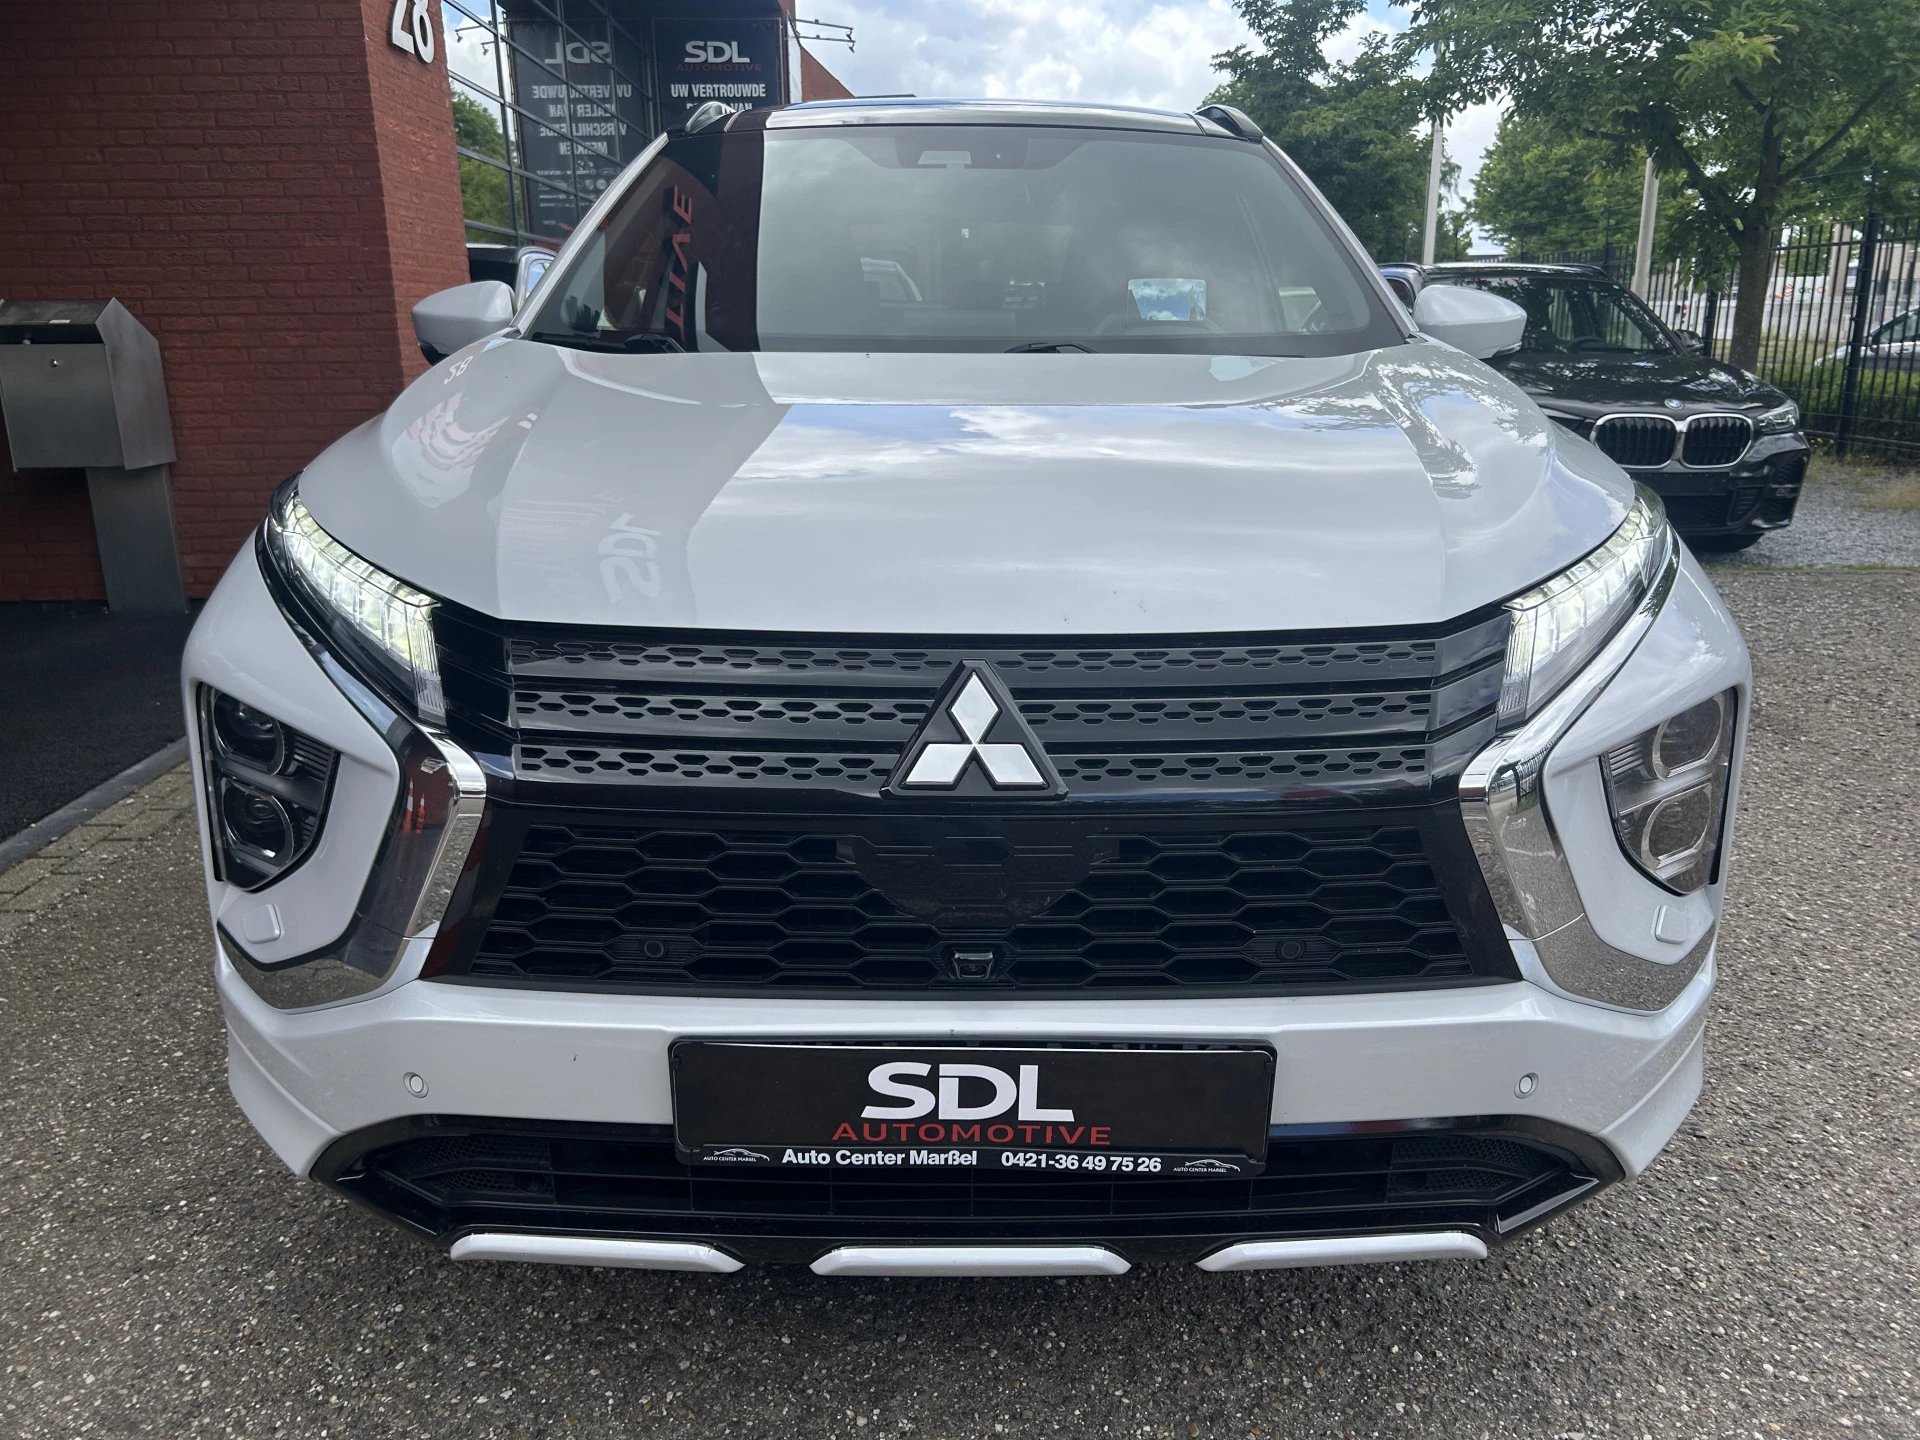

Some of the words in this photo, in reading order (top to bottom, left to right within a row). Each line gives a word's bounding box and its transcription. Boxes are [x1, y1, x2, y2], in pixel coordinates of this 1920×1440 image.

[684, 41, 751, 63] SDL
[676, 63, 762, 72] AUTOMOTIVE
[670, 84, 690, 98] UW
[691, 84, 767, 98] VERTROUWDE
[861, 1061, 1075, 1122] SDL
[831, 1122, 1112, 1145] AUTOMOTIVE
[782, 1149, 831, 1165] Auto
[835, 1150, 905, 1166] Center
[909, 1150, 977, 1166] Marßel
[1001, 1152, 1079, 1170] 0421-36
[1082, 1156, 1107, 1171] 49
[1110, 1157, 1133, 1172] 75
[1137, 1157, 1162, 1172] 26
